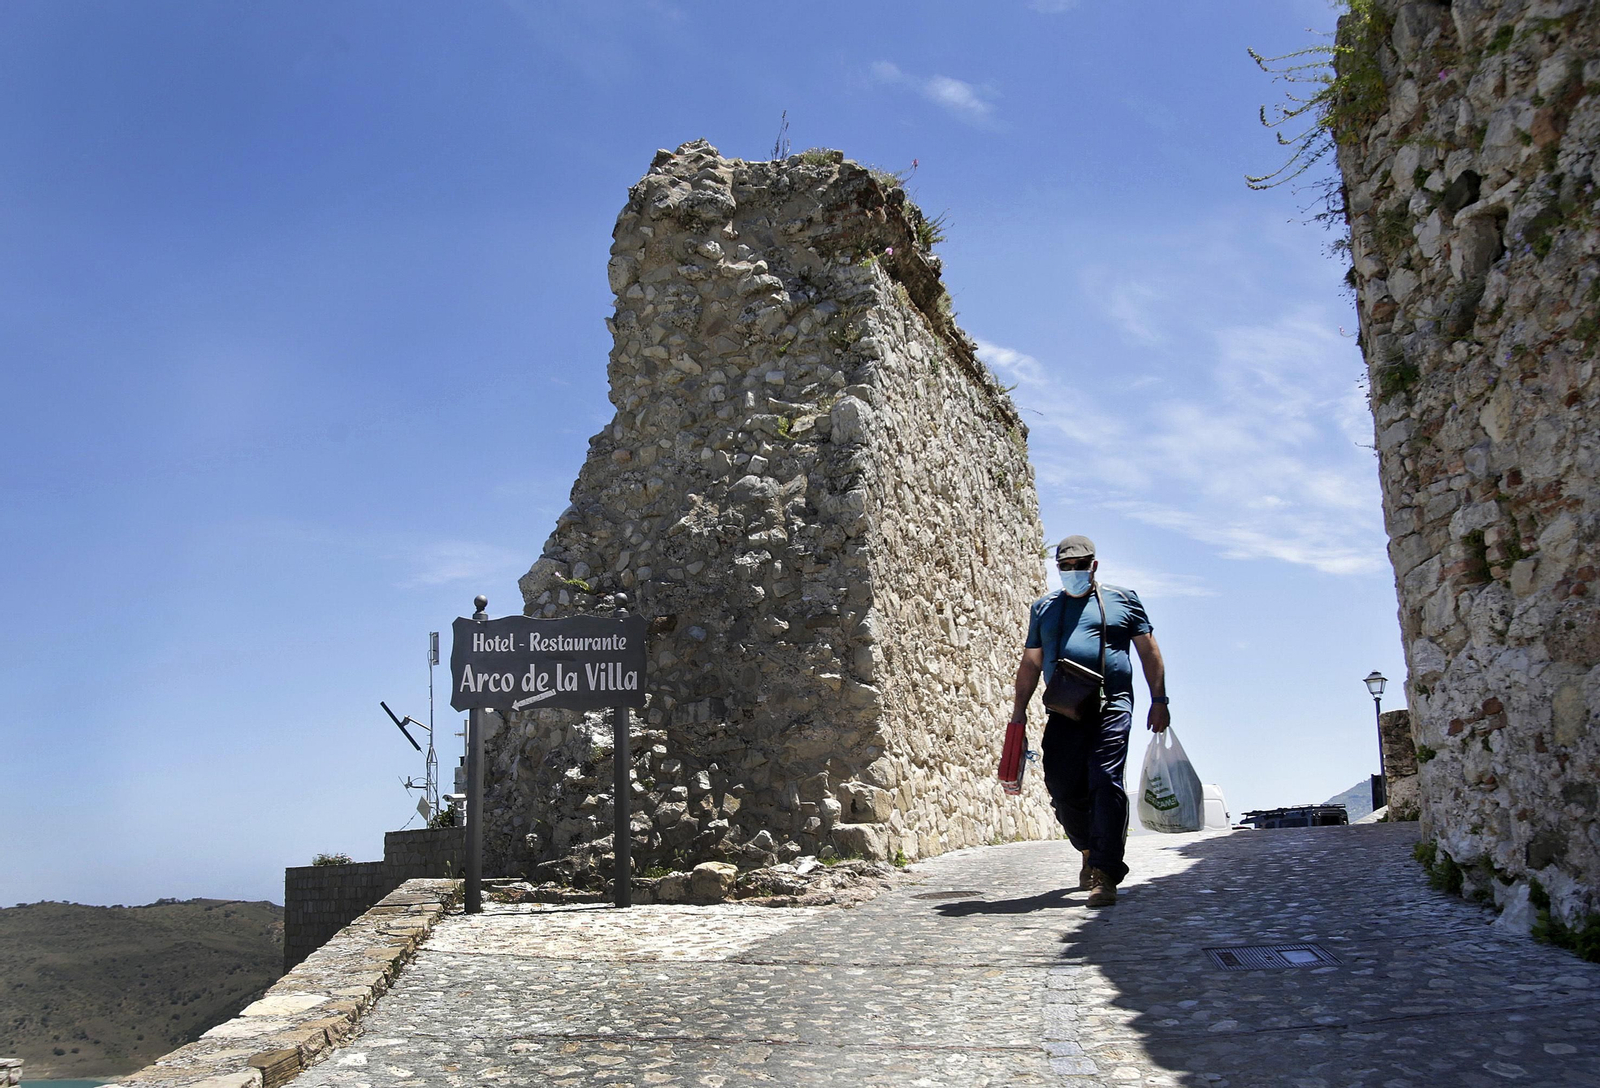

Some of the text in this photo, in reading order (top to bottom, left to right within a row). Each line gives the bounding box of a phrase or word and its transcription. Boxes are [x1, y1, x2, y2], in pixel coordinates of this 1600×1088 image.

[473, 633, 515, 652] Hotel
[530, 632, 627, 652] Restaurante
[460, 662, 638, 692] Arco de la Villa
